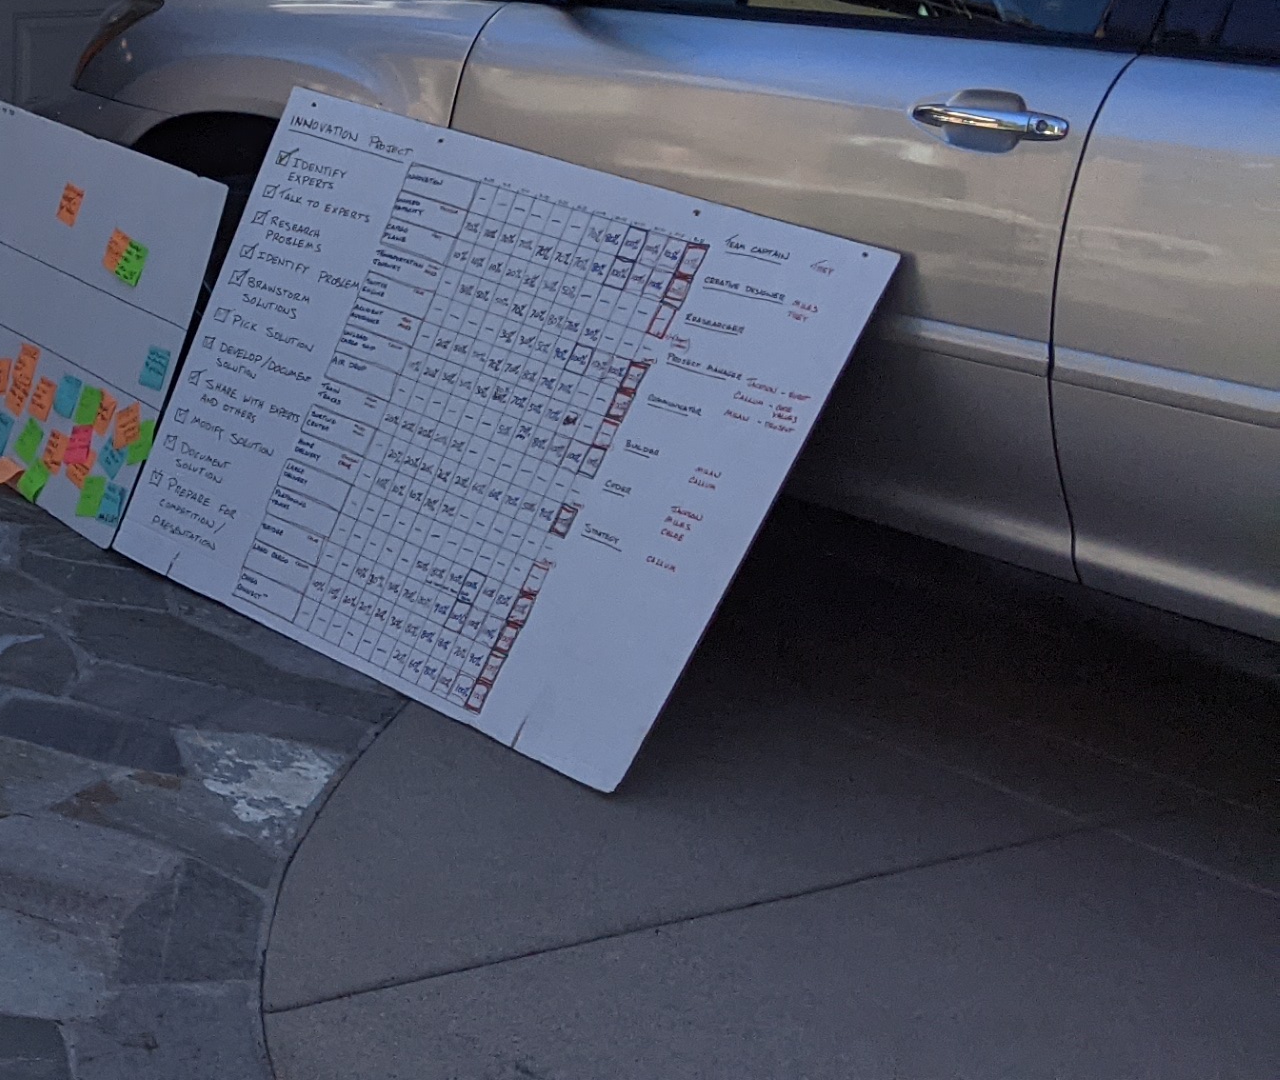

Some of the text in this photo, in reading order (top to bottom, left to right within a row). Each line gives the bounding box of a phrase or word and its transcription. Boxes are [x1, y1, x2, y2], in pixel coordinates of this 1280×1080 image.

[290, 115, 413, 156] INNOVATION PROJECT
[287, 172, 334, 189] EXPERTS
[292, 157, 347, 178] IDENTIFY
[279, 187, 370, 223] TALK TO EXPERTS
[265, 229, 321, 252] PROBLEMS
[270, 216, 320, 238] RESEARCH
[725, 234, 790, 260] TEAM CAPTAIN
[257, 251, 359, 290] IDENTIFY PROBLEM
[247, 277, 310, 303] BRAINSTORM
[242, 293, 297, 319] SOLUTIONS
[232, 314, 314, 352] PICK SOLUTION
[216, 358, 256, 379] SOLUTION
[200, 393, 256, 423] AND OTHERS
[205, 379, 300, 423] SHARE WITH EXPERTS
[190, 416, 274, 456] MODIFY SOLUTION
[181, 441, 231, 468] DOCUMENT
[175, 458, 223, 483] SOLUTION
[167, 477, 236, 519] PREPARE FOR
[151, 515, 215, 550] PRESENTATION
